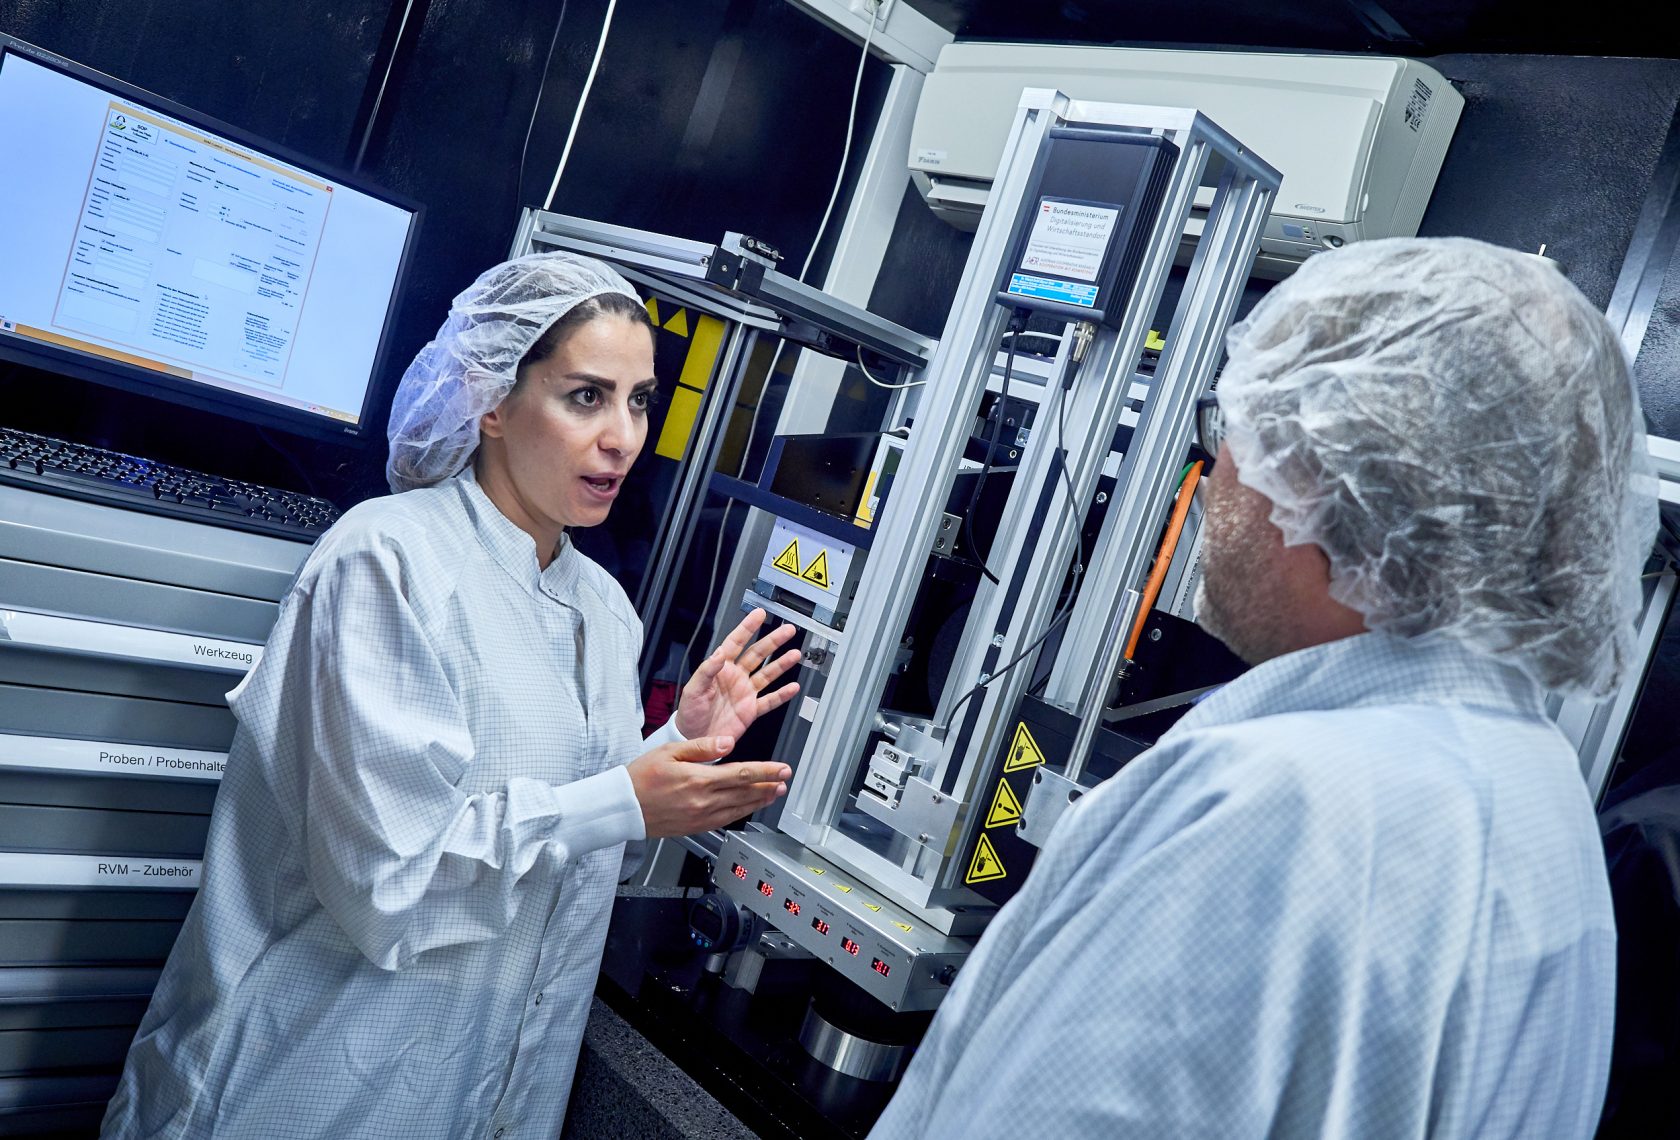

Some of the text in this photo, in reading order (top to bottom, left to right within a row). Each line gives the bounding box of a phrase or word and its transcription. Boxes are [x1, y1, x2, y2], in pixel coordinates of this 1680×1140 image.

[1052, 207, 1109, 221] Bundesministerium
[1049, 216, 1106, 230] Digitalisierung und
[1047, 225, 1106, 240] Wirtschaftsstandort
[193, 644, 253, 664] Werkzeug
[99, 751, 145, 766] Proben
[98, 863, 129, 875] RVM
[144, 864, 193, 877] Zubehör
